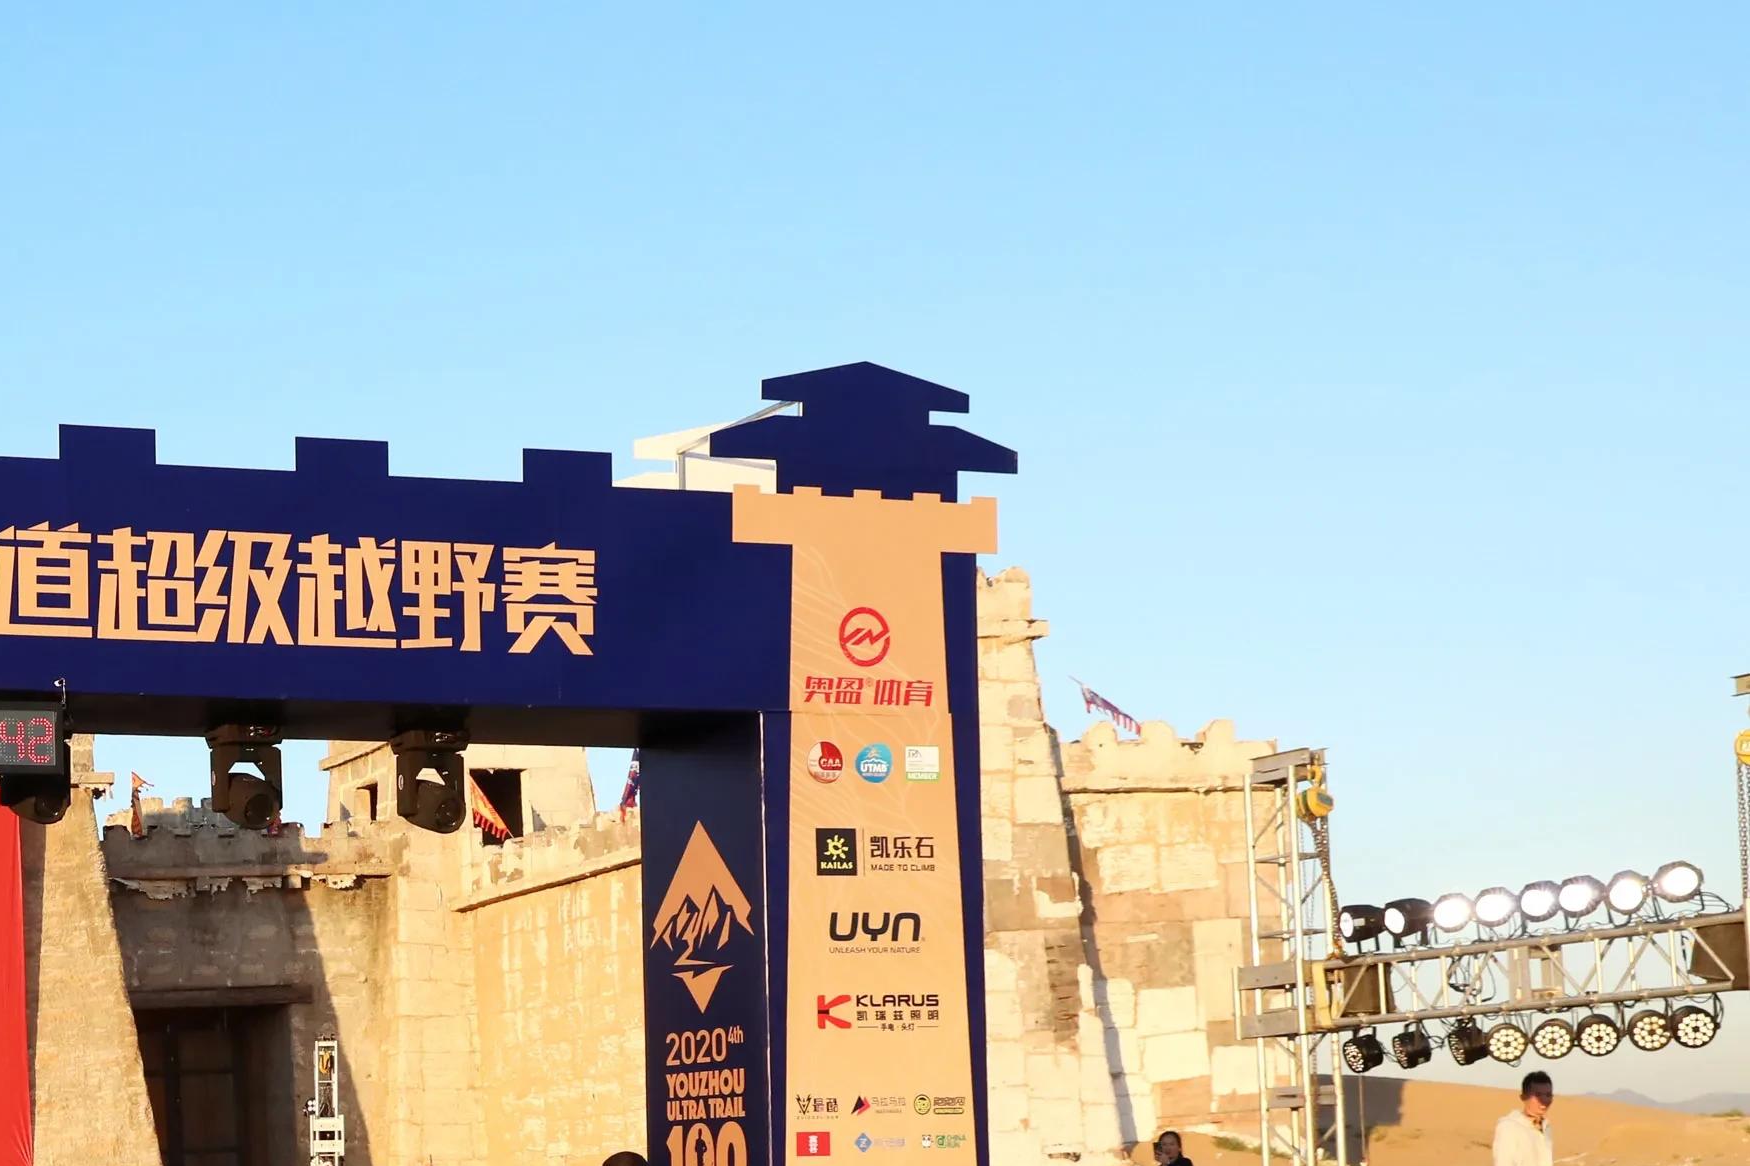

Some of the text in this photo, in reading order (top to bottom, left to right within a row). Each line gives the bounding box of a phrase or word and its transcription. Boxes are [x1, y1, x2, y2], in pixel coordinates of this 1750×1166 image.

[870, 835, 935, 859] 凯乐石
[820, 861, 854, 870] KAILAS
[856, 994, 939, 1007] KLARUS
[666, 1025, 744, 1067] 2020 4th
[666, 1068, 745, 1098] YOUZHOU
[666, 1096, 746, 1122] ULTRA TRAIL
